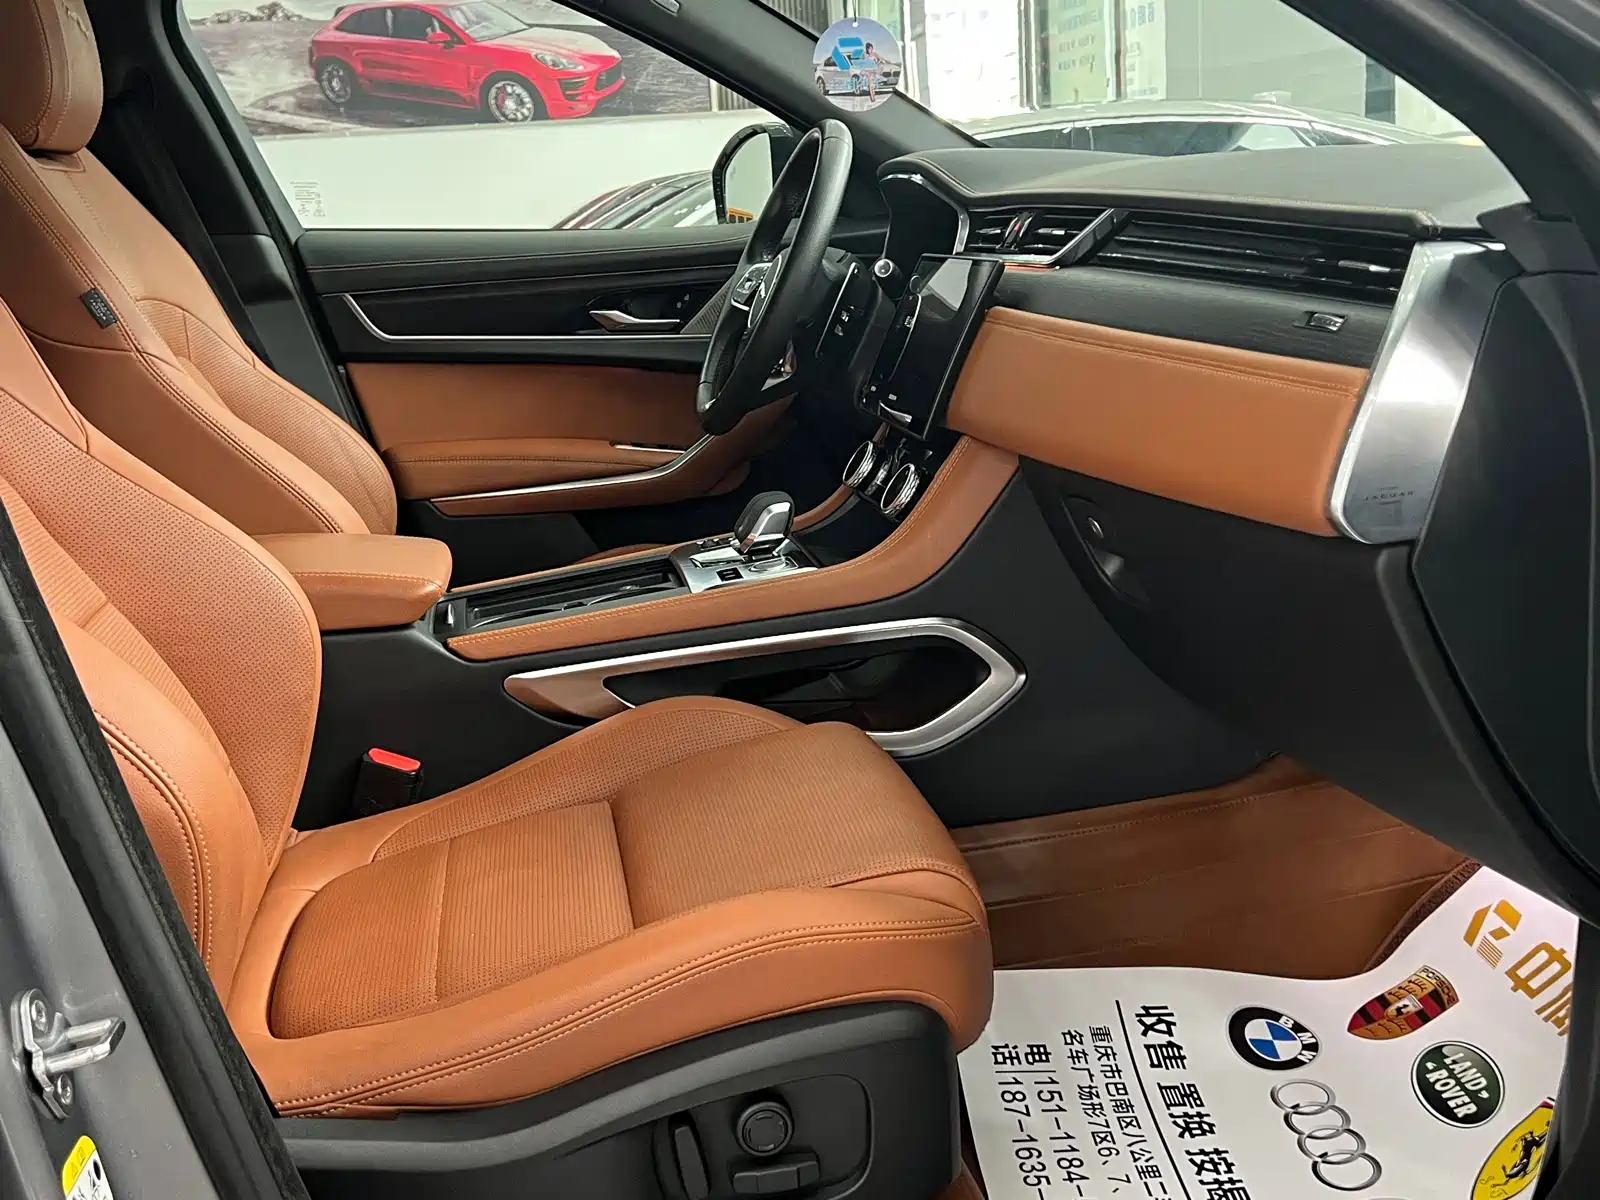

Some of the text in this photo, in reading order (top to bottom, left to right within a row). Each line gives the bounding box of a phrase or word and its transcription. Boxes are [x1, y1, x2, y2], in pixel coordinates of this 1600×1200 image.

[1363, 490, 1415, 501] JAGUAR
[1419, 967, 1457, 1007] PORSCHE
[990, 1043, 1022, 1067] 话
[1024, 1043, 1052, 1066] 电
[1135, 1005, 1187, 1070] 收售
[1279, 1015, 1317, 1063] BMW
[1425, 1068, 1478, 1119] ROVER
[1443, 1053, 1488, 1092] LAND
[1089, 1025, 1171, 1200] 重庆市巴南区八公里二
[1156, 1082, 1217, 1139] 置换
